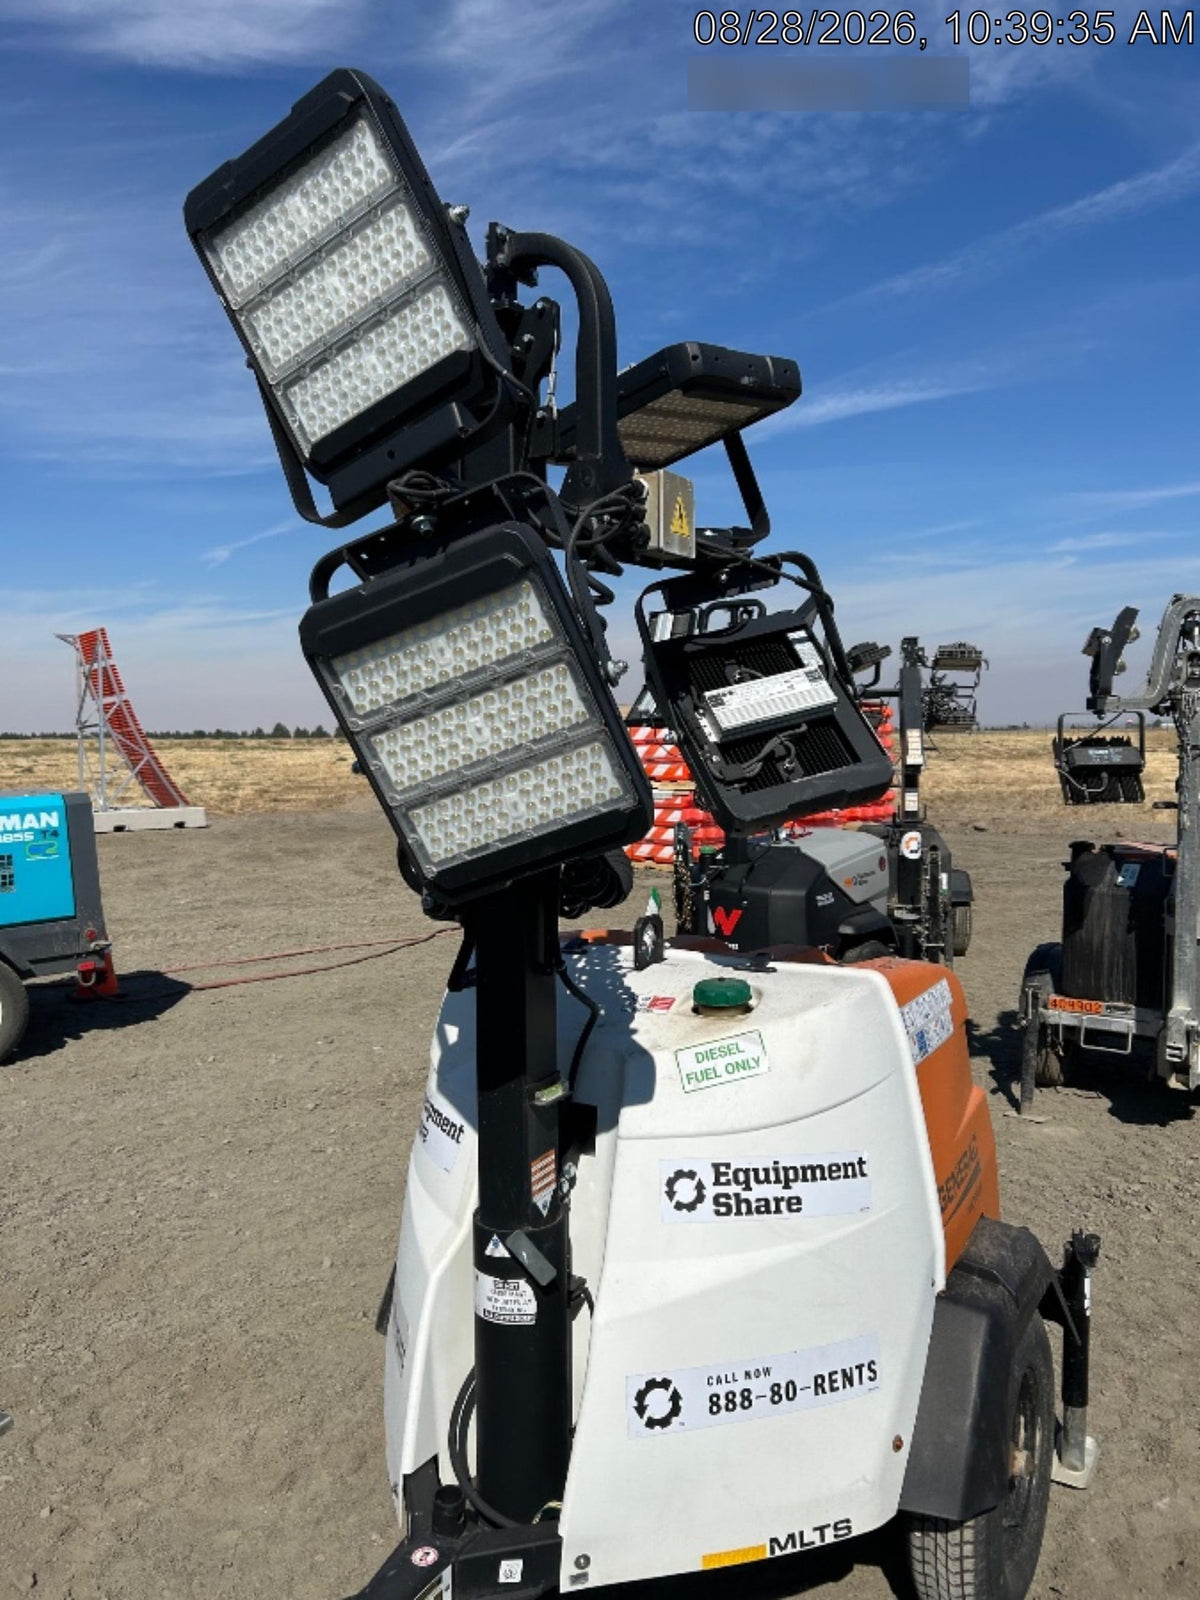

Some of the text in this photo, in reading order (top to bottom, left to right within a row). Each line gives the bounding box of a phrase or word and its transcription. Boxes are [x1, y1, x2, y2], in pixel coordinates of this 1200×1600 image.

[41, 829, 59, 839] T4
[694, 1041, 745, 1064] DIESEL
[685, 1056, 761, 1086] FUEL ONLY
[711, 1156, 868, 1192] Equipment
[712, 1192, 803, 1217] Share
[706, 1366, 772, 1387] CALL NOW
[708, 1359, 878, 1416] 888-80-RENTS
[769, 1517, 853, 1556] MLTS
